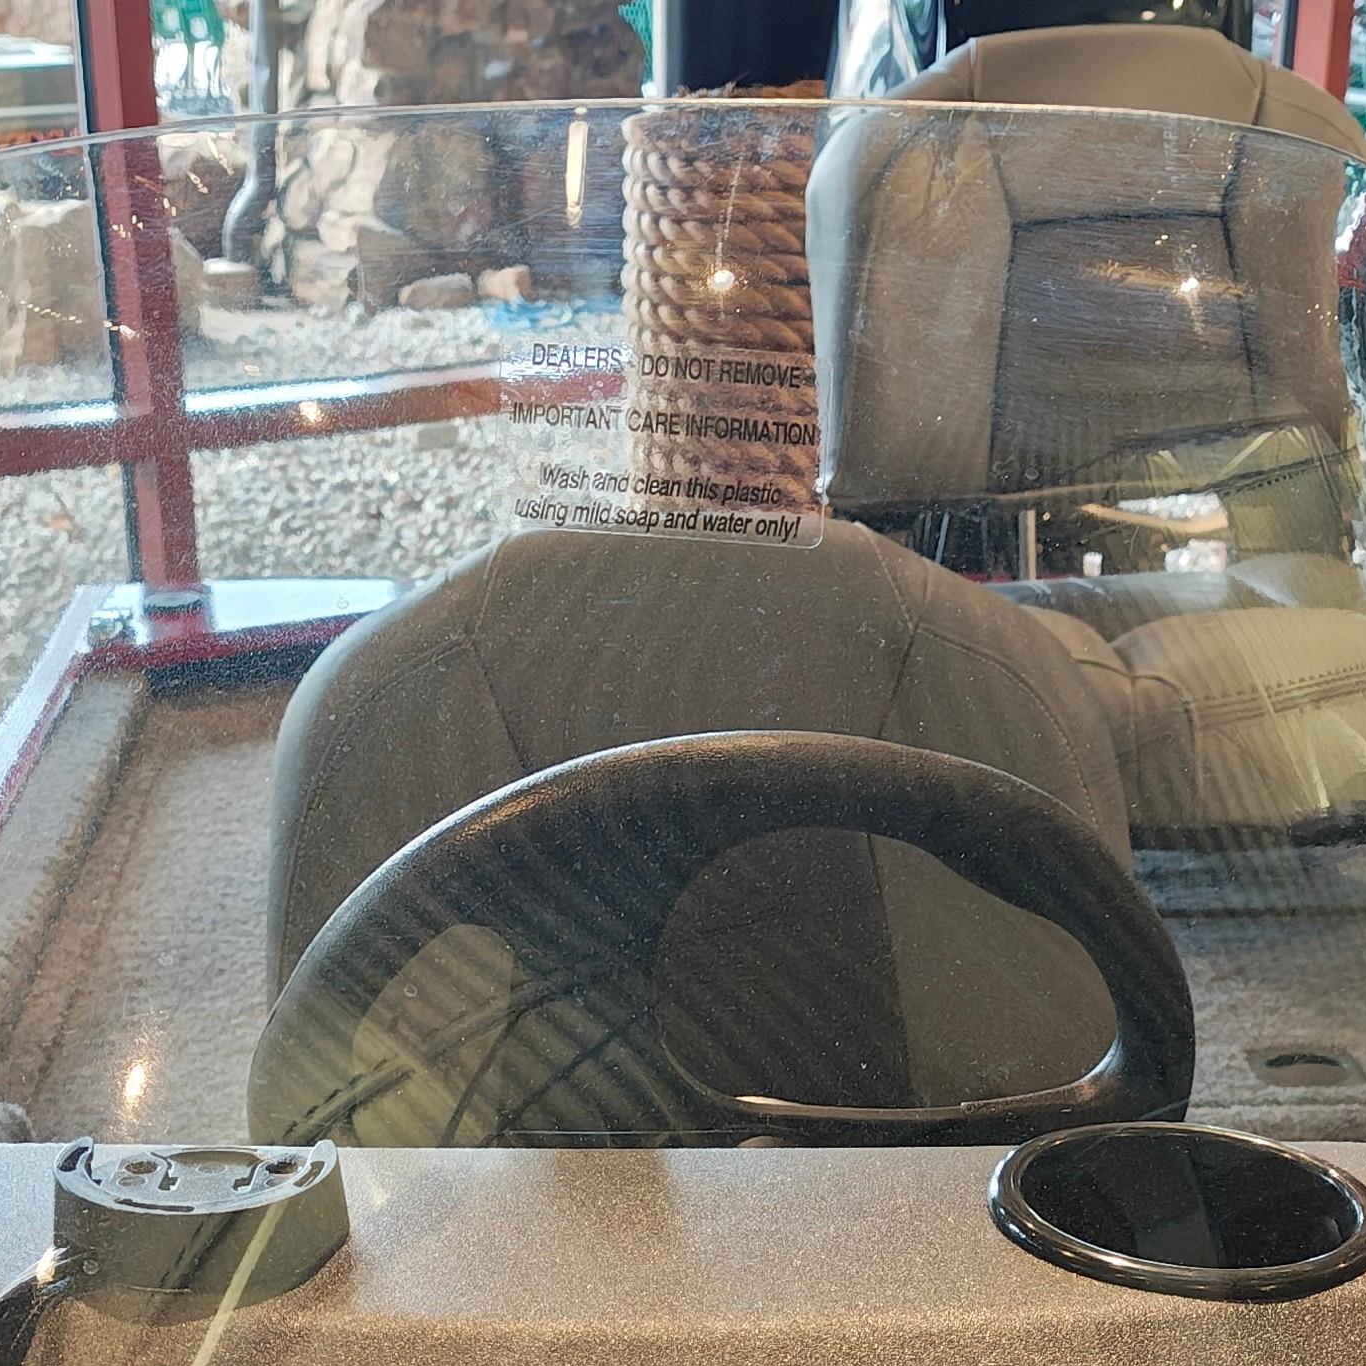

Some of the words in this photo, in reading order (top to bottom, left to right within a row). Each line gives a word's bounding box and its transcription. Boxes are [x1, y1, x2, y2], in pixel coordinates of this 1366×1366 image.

[532, 343, 623, 372] DEALERS
[641, 354, 669, 378] DO
[674, 357, 715, 382] NOT
[719, 360, 802, 389] REMOVE
[511, 401, 624, 431] IMPORTANT
[626, 407, 681, 436] CARE
[684, 412, 817, 446] INFORMATION
[540, 461, 590, 490] Wash
[592, 468, 631, 493] and
[634, 473, 681, 496] clean
[685, 477, 718, 501] this
[722, 480, 782, 506] plastic
[515, 496, 568, 527] using
[572, 501, 613, 524] mild
[614, 508, 660, 533] soap
[663, 508, 700, 531] and
[703, 513, 753, 535] water
[755, 515, 802, 542] only!
